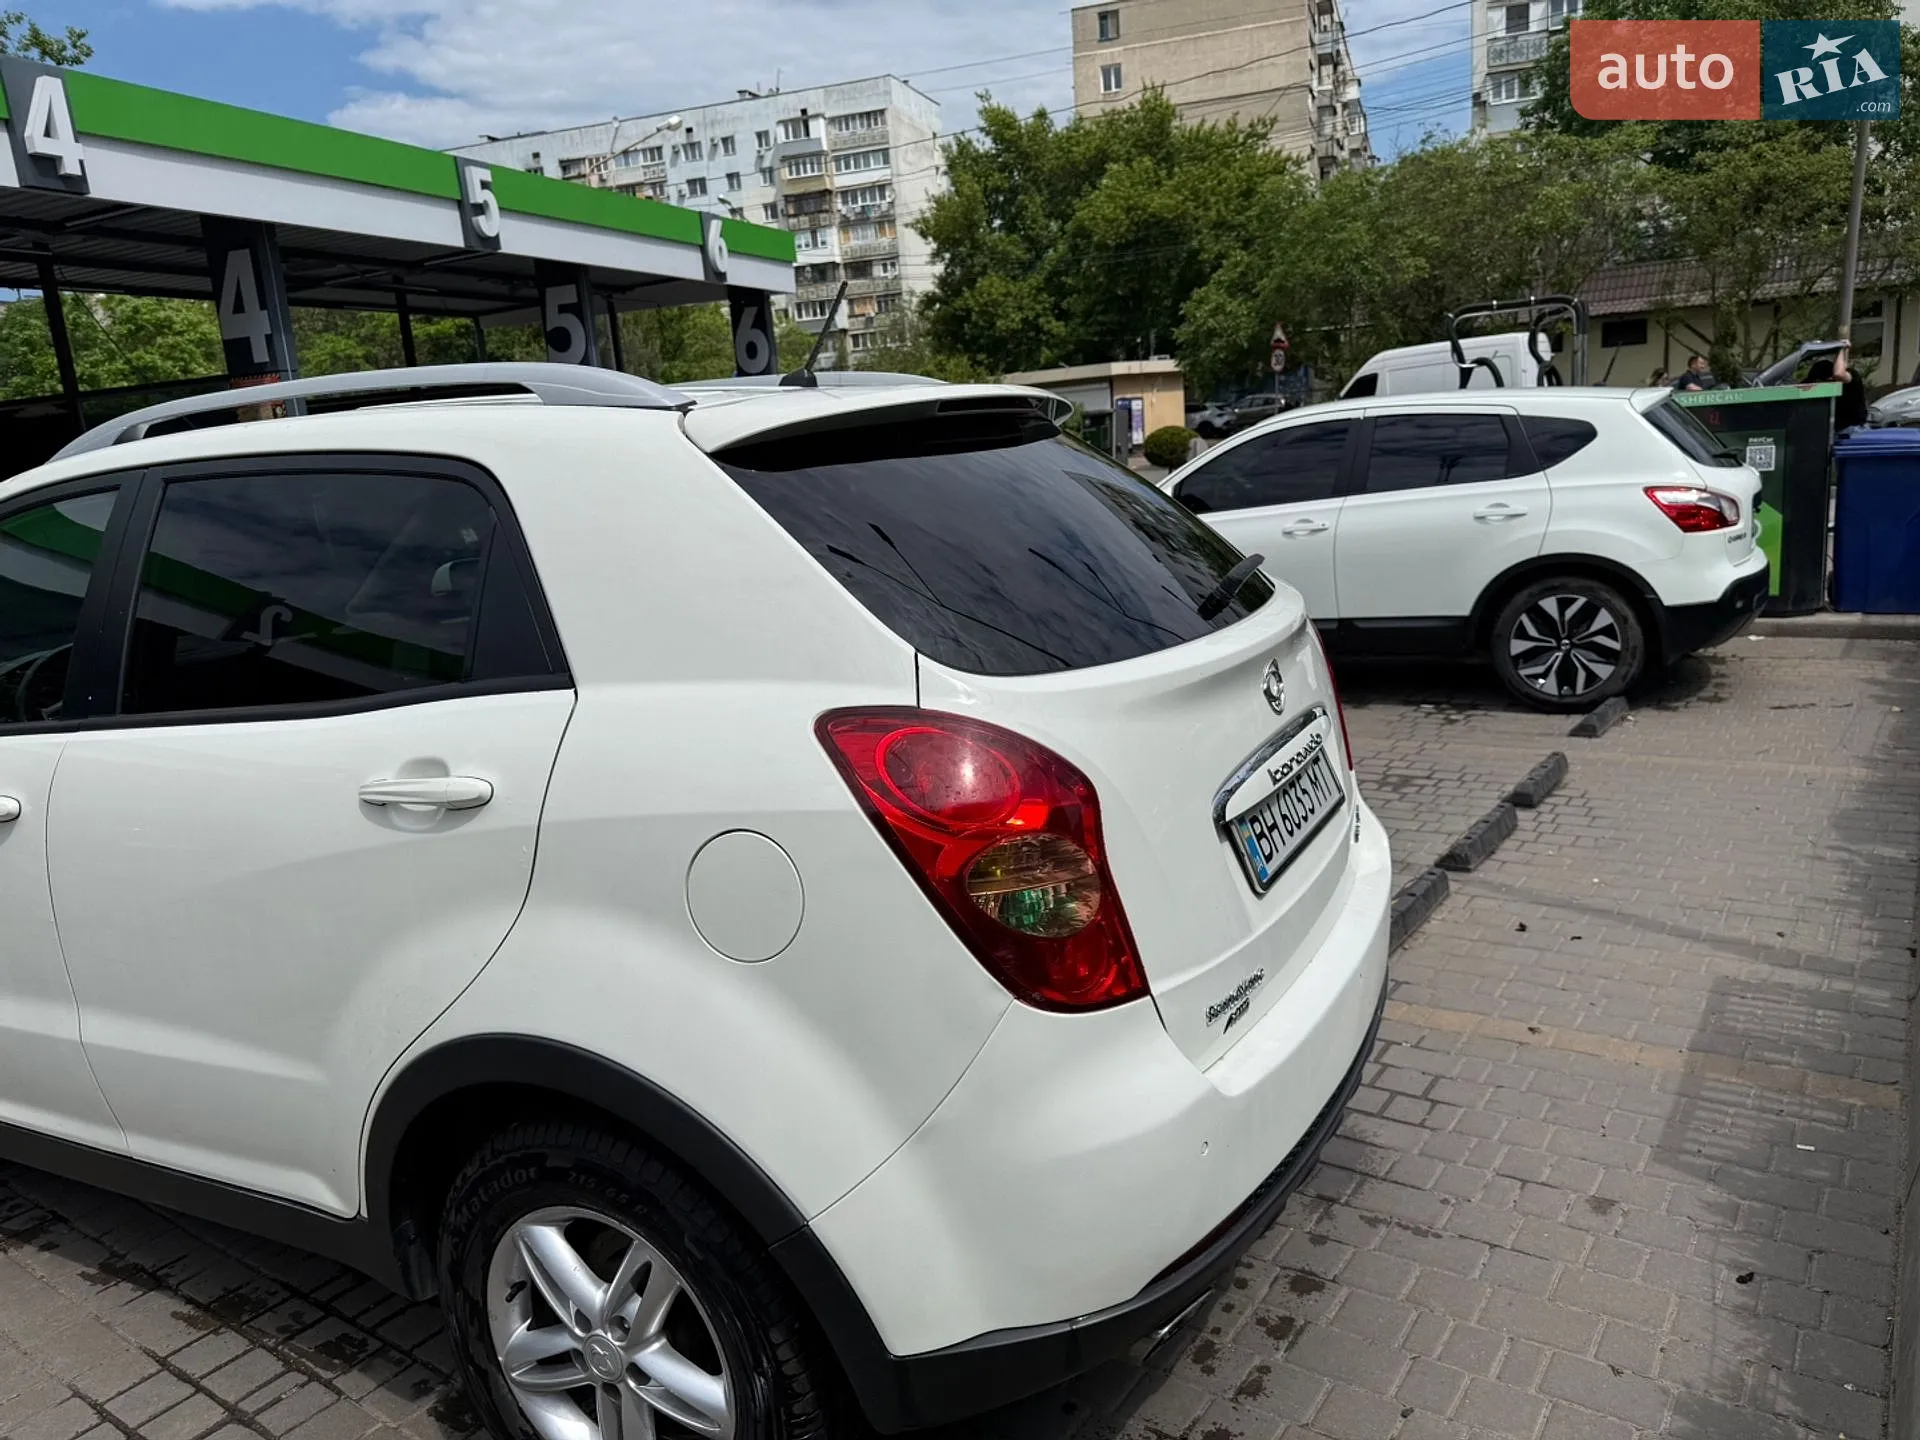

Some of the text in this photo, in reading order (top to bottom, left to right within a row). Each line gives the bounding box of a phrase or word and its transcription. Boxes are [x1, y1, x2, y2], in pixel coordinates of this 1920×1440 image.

[24, 74, 86, 178] 4
[464, 165, 500, 239] 5
[708, 219, 729, 274] 6
[218, 249, 272, 363] 4
[546, 284, 587, 365] 5
[735, 306, 769, 375] 6
[1249, 755, 1332, 863] BH 6035 MT
[449, 1166, 537, 1232] Matador
